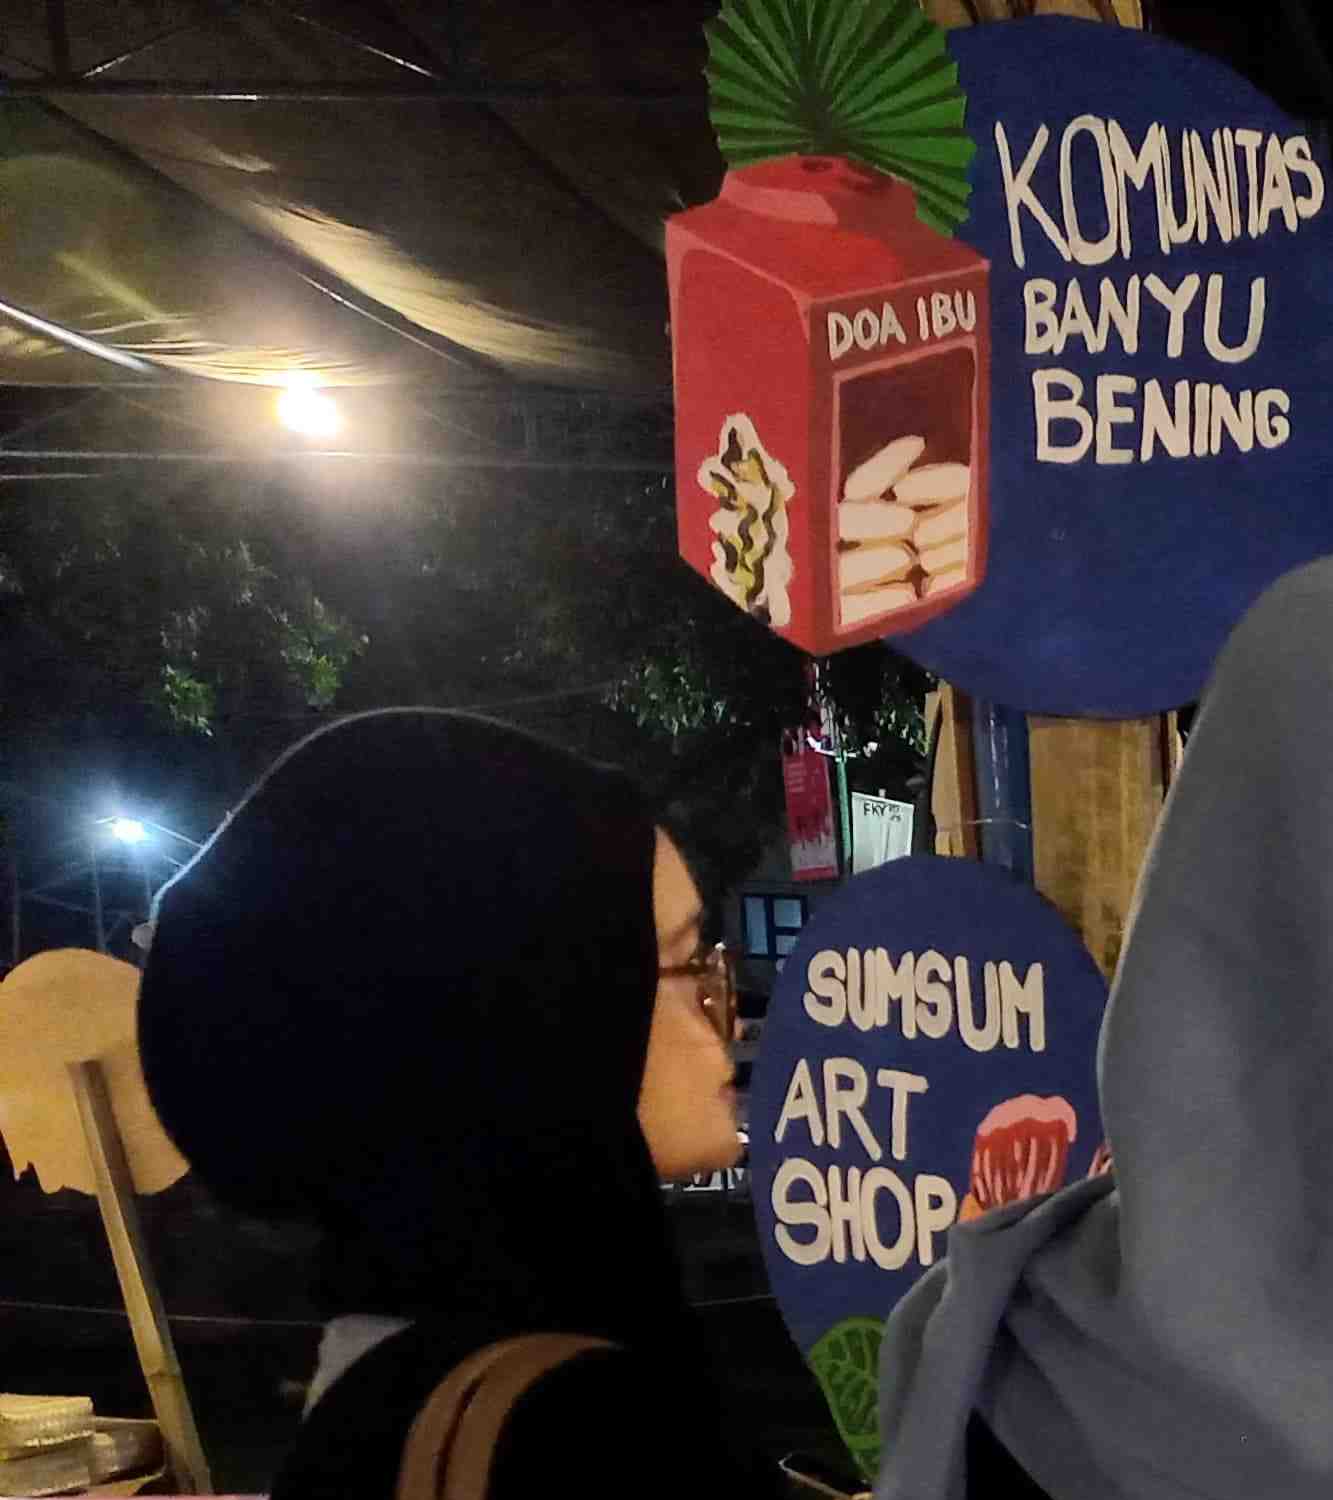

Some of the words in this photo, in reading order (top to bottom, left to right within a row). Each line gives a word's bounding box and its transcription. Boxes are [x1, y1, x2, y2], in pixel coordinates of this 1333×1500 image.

[994, 114, 1325, 268] KOMUNITAS
[827, 307, 906, 361] DOA
[918, 290, 977, 341] IBU
[1023, 274, 1265, 363] BANYU
[1031, 367, 1291, 465] BENING
[803, 947, 1046, 1053] SUMSUM
[773, 1056, 929, 1161] ART
[771, 1156, 957, 1272] SHOP
